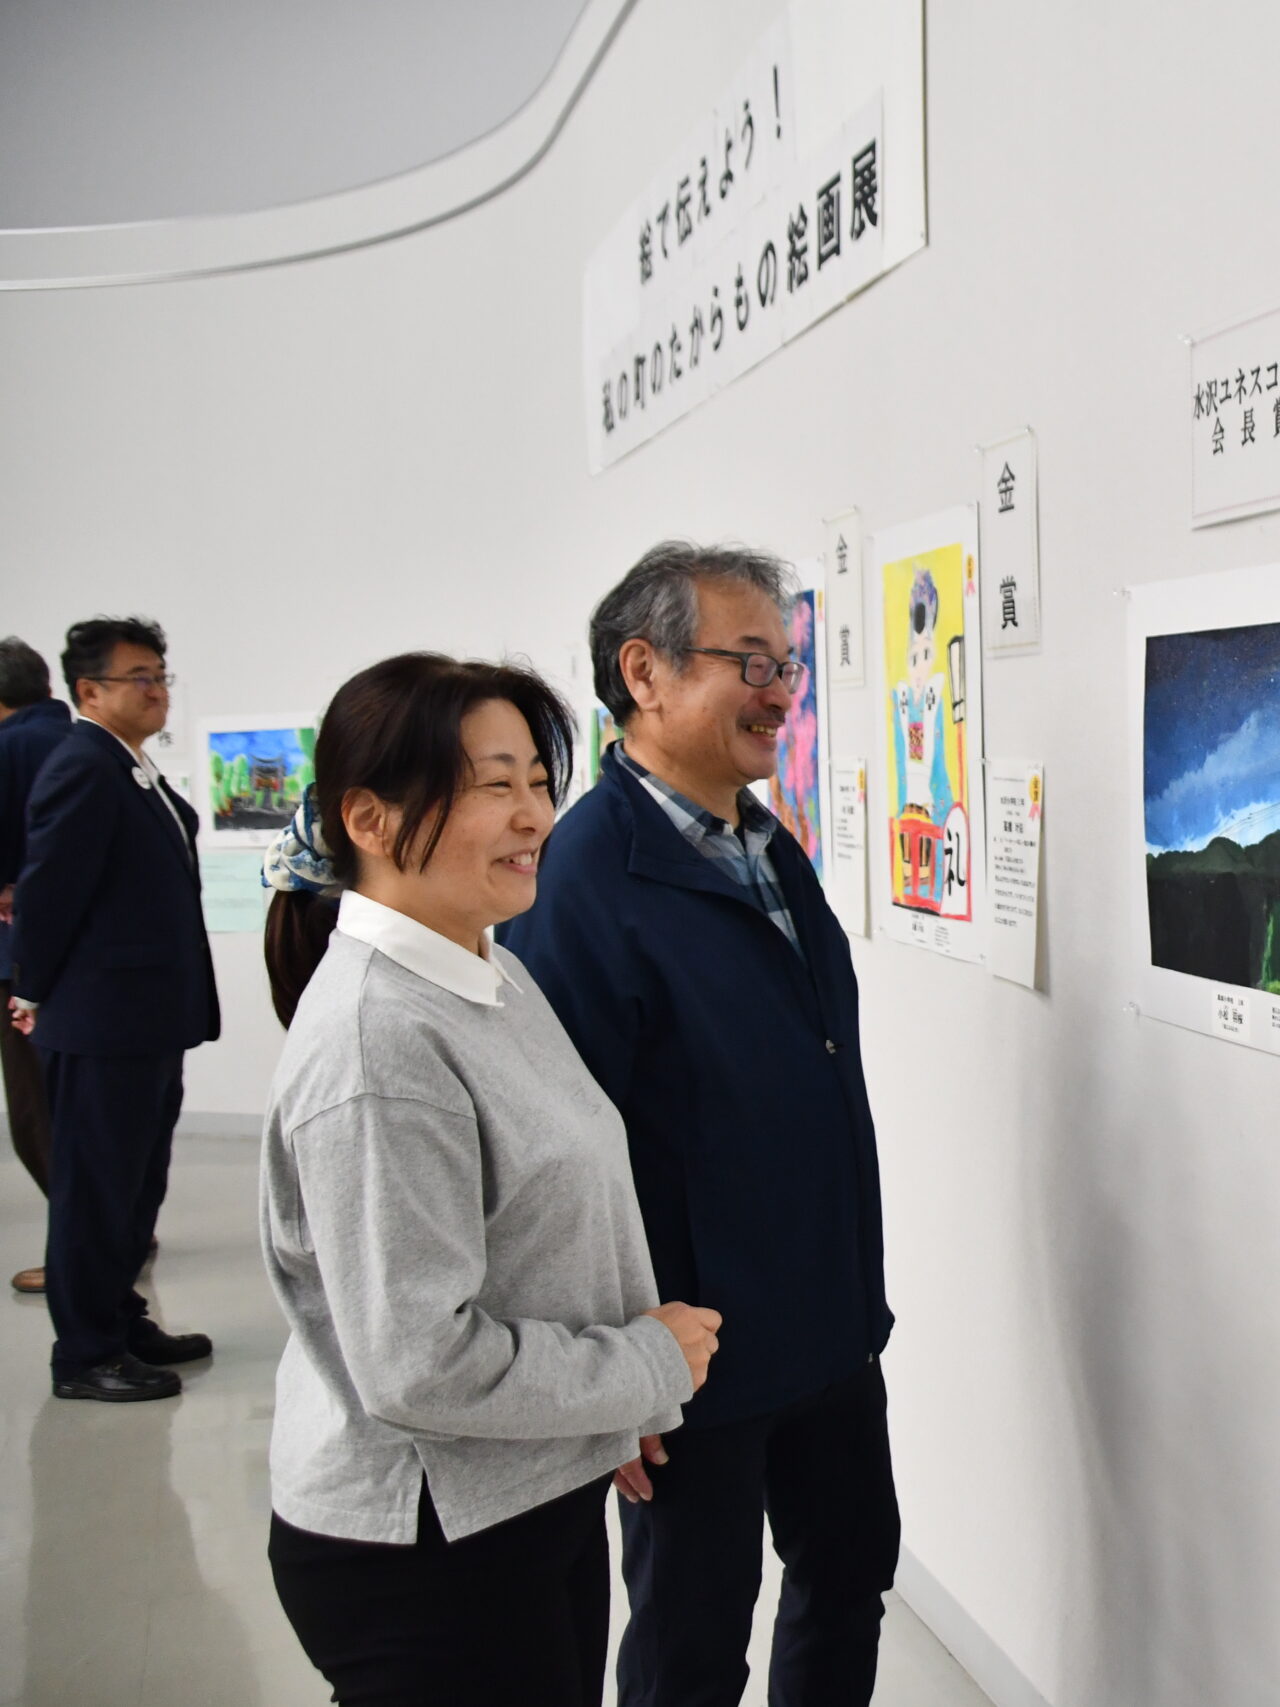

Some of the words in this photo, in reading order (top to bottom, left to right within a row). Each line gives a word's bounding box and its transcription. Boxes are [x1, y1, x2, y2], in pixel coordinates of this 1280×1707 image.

[602, 138, 879, 434] 私の町のたからもの絵画展
[944, 828, 966, 896] 礼
